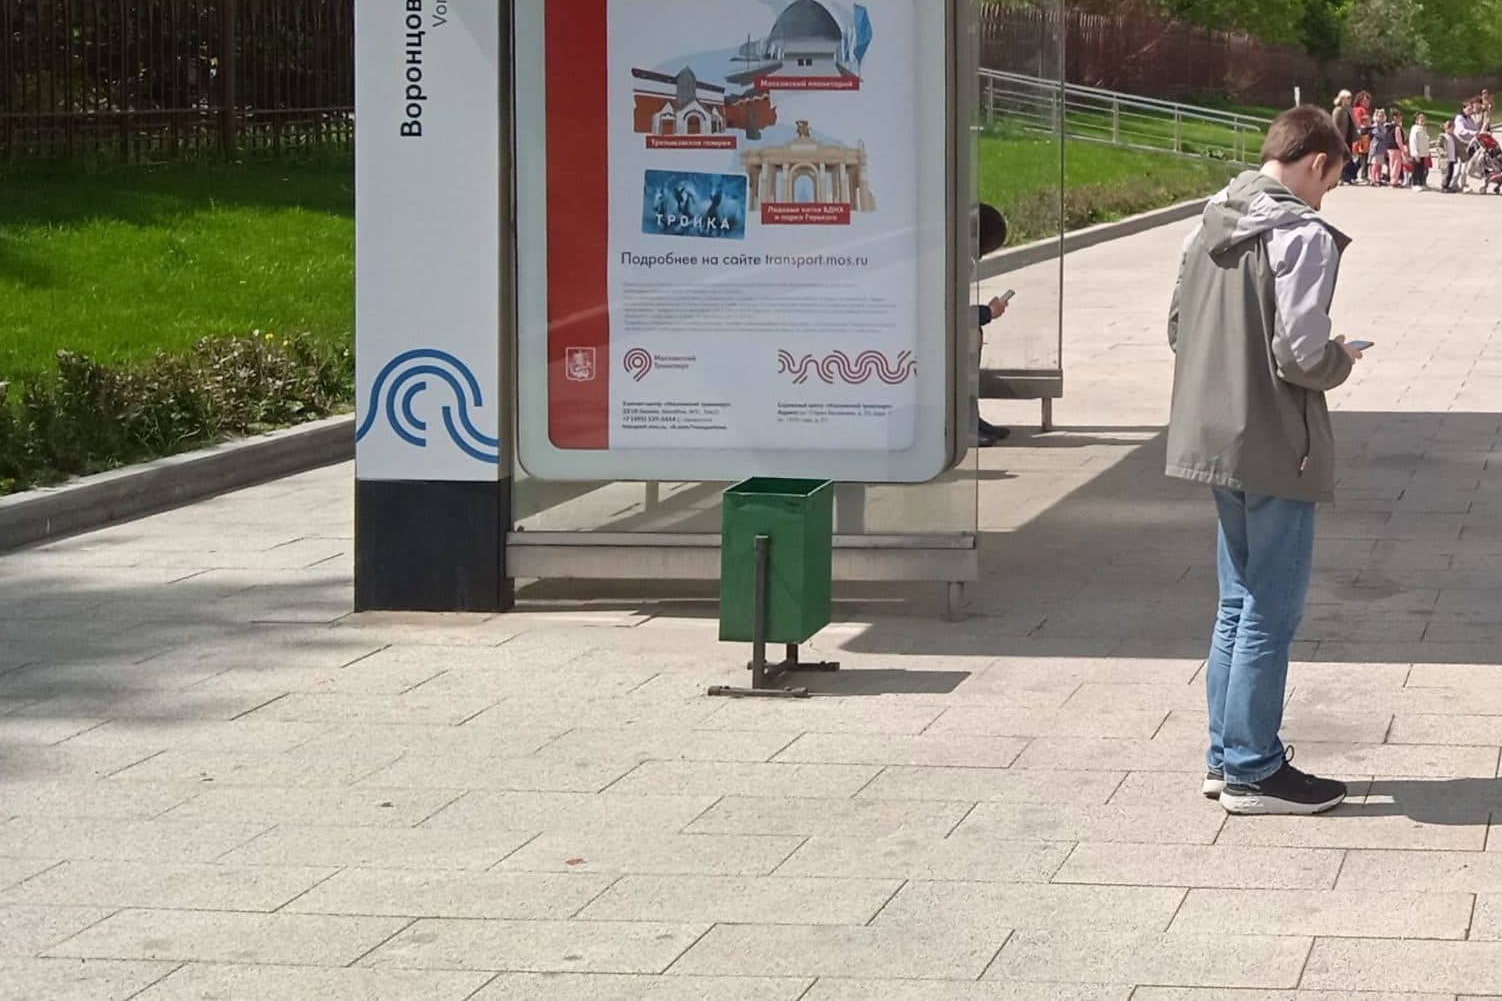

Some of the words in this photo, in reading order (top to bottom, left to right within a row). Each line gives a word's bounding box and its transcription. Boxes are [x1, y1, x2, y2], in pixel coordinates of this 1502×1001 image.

[620, 251, 698, 268] Подробнее
[702, 255, 719, 266] на
[723, 253, 762, 266] сайте
[765, 254, 869, 270] transport.mos.ru
